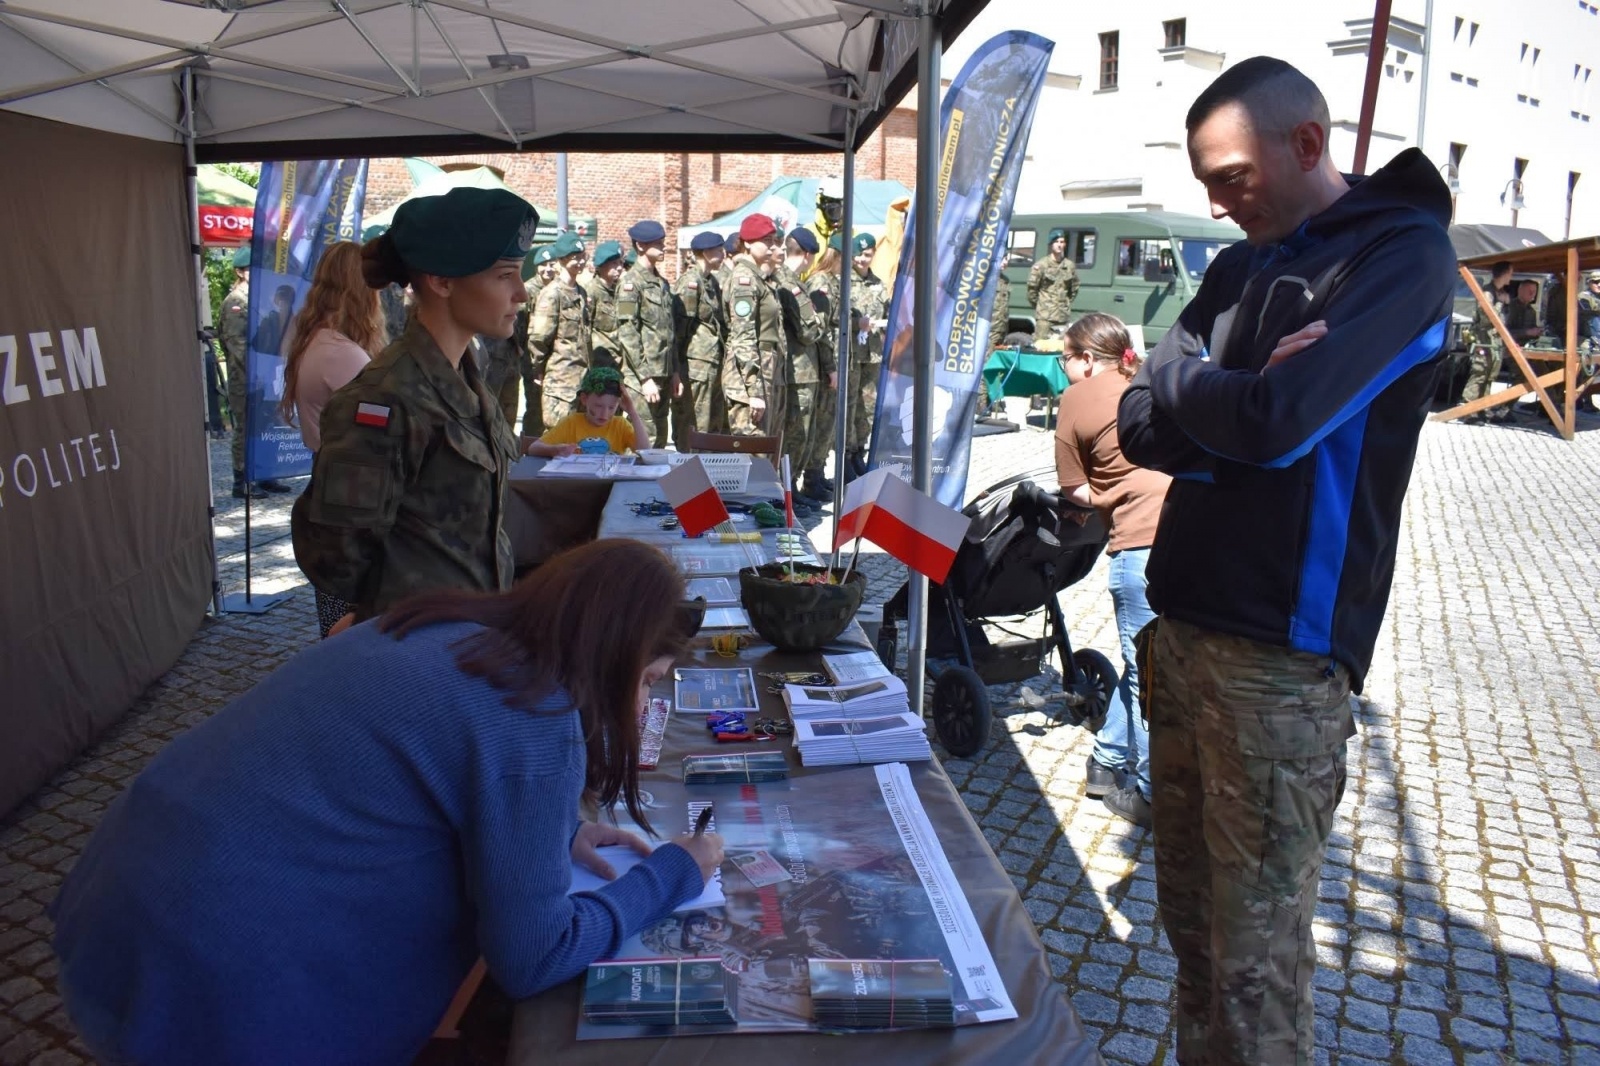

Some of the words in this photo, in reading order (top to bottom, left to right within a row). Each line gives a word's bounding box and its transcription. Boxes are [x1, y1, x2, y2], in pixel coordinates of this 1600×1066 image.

[946, 228, 982, 372] DOBROWOLNA
[959, 297, 980, 373] SŁUŻBA
[0, 326, 107, 406] ZEM
[631, 967, 642, 1001] KANDYDAT
